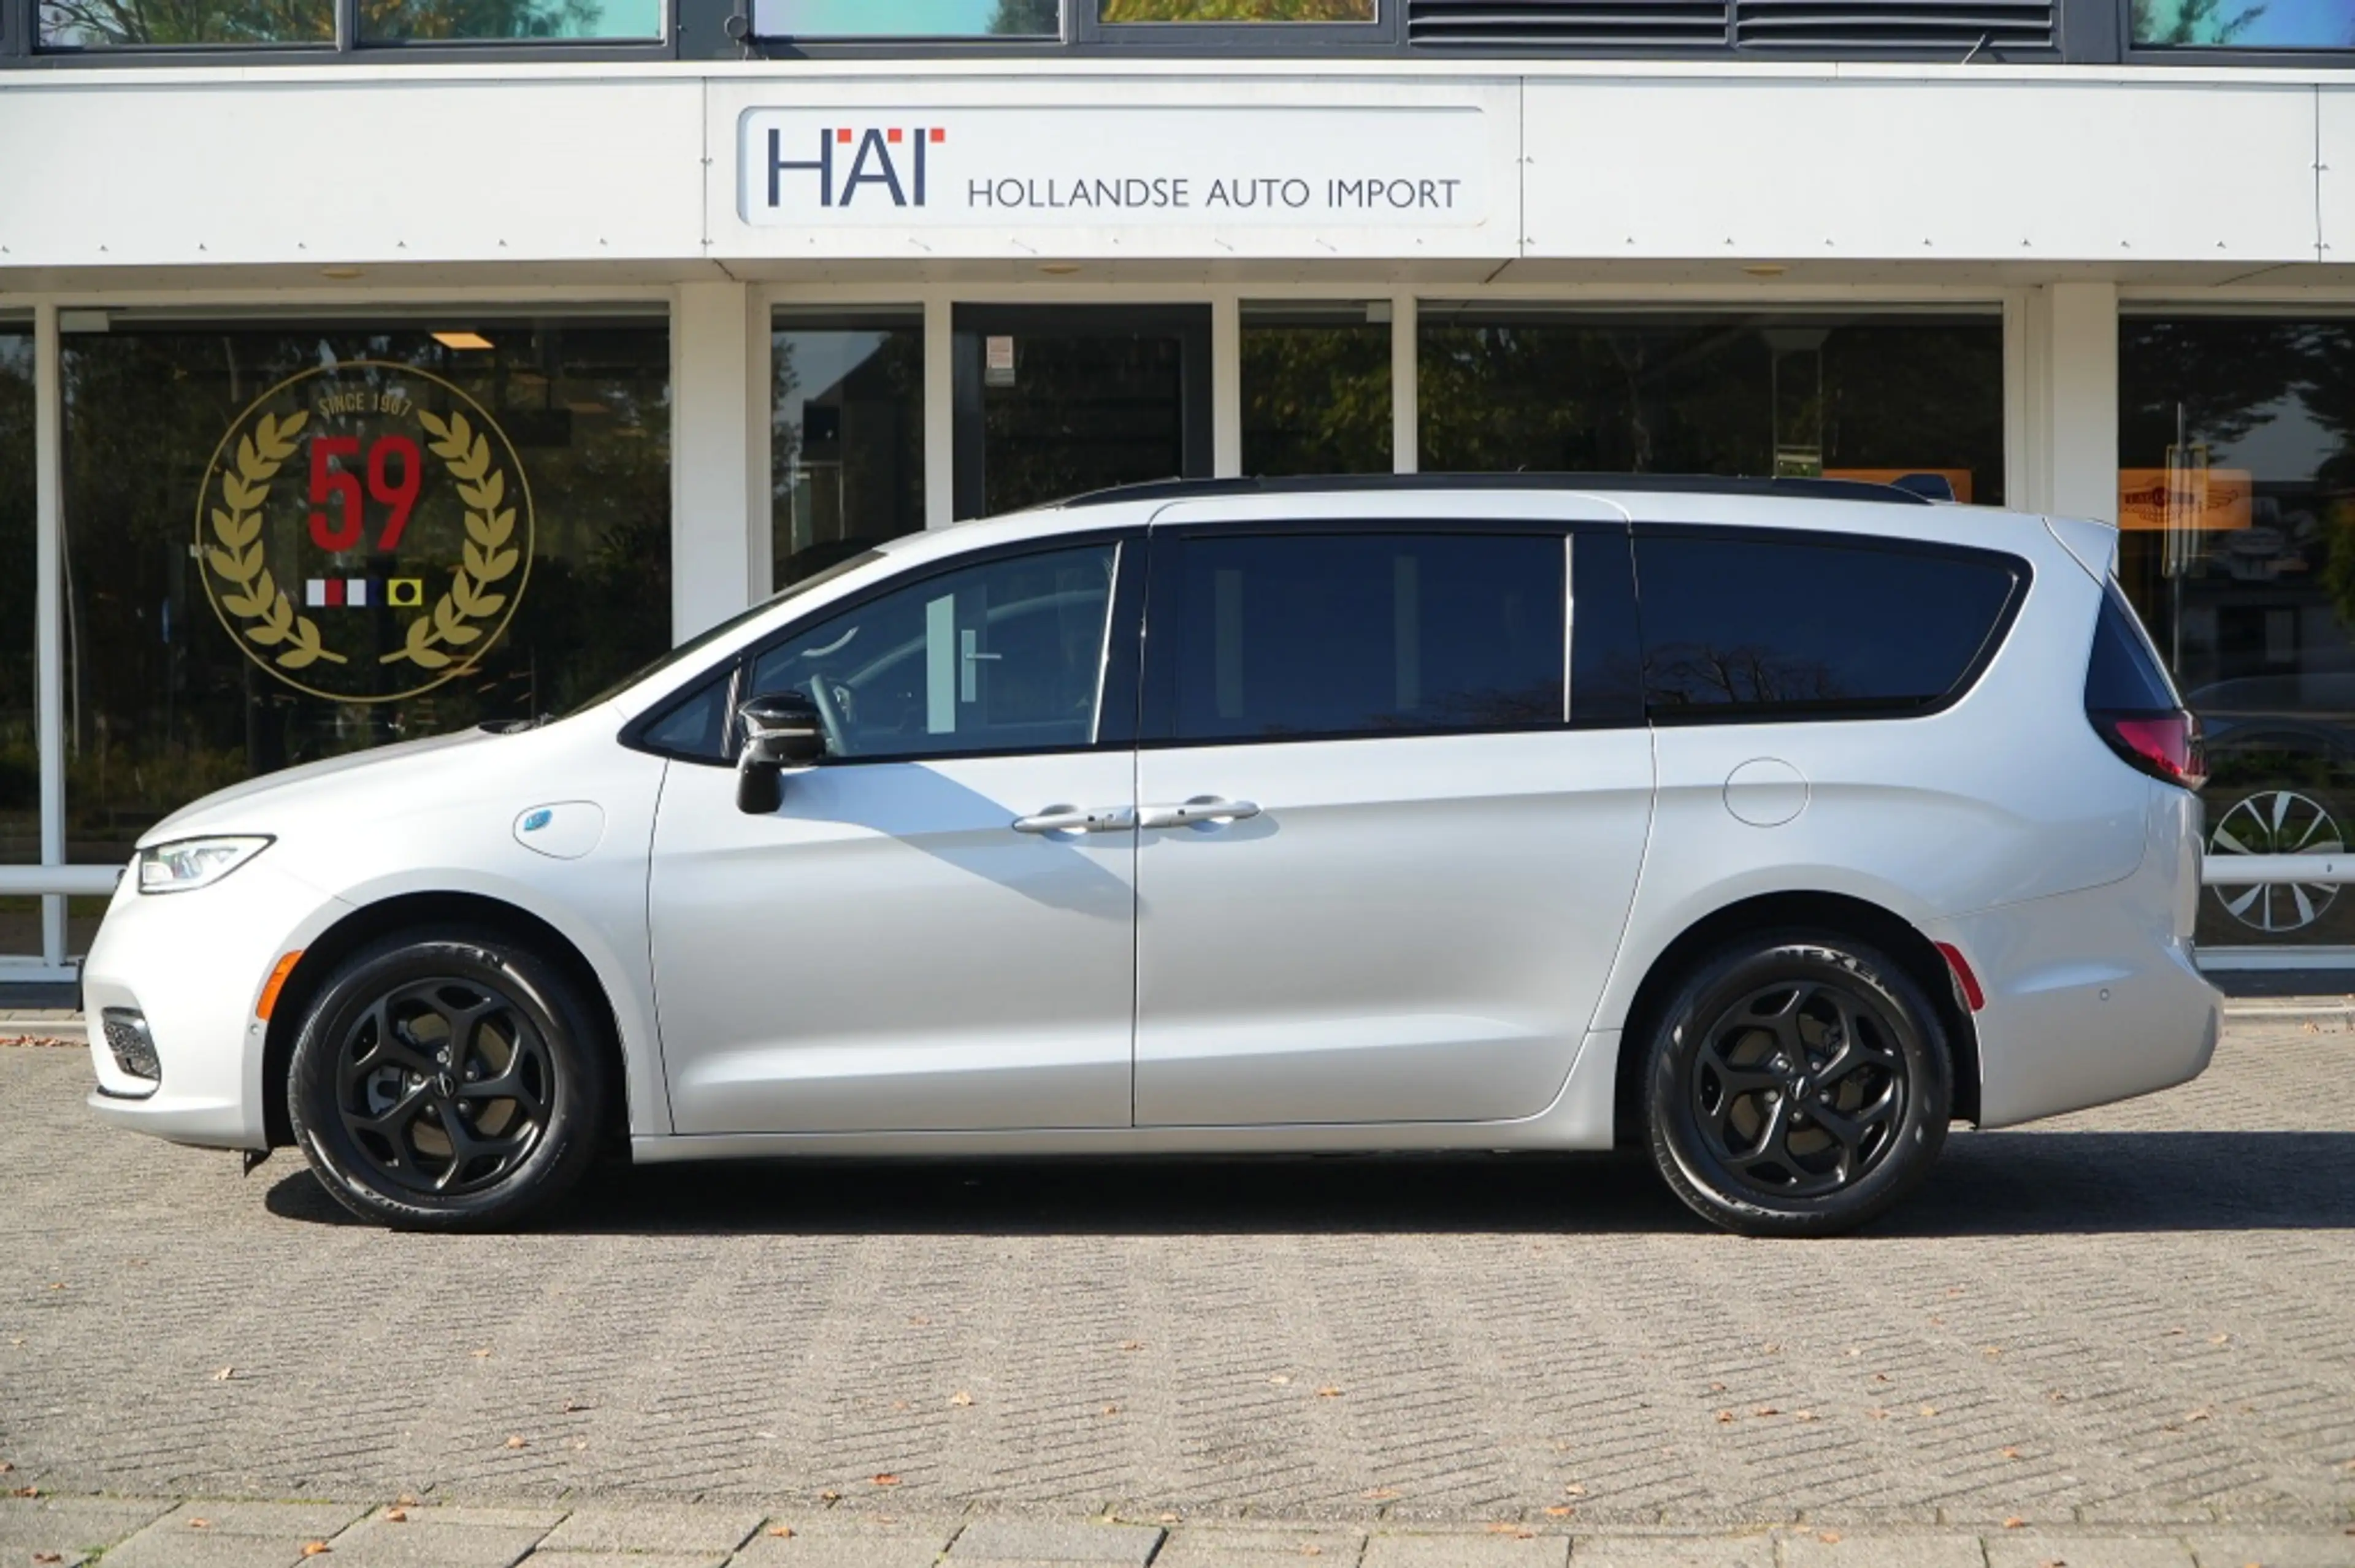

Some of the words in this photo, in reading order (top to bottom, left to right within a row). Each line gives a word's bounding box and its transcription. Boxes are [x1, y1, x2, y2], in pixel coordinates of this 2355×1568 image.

[970, 178, 1188, 207] HOLLANDSE
[1206, 178, 1309, 207] AUTO
[1329, 178, 1459, 207] IMPORT
[318, 393, 365, 420] SINCE
[309, 435, 422, 551] 59
